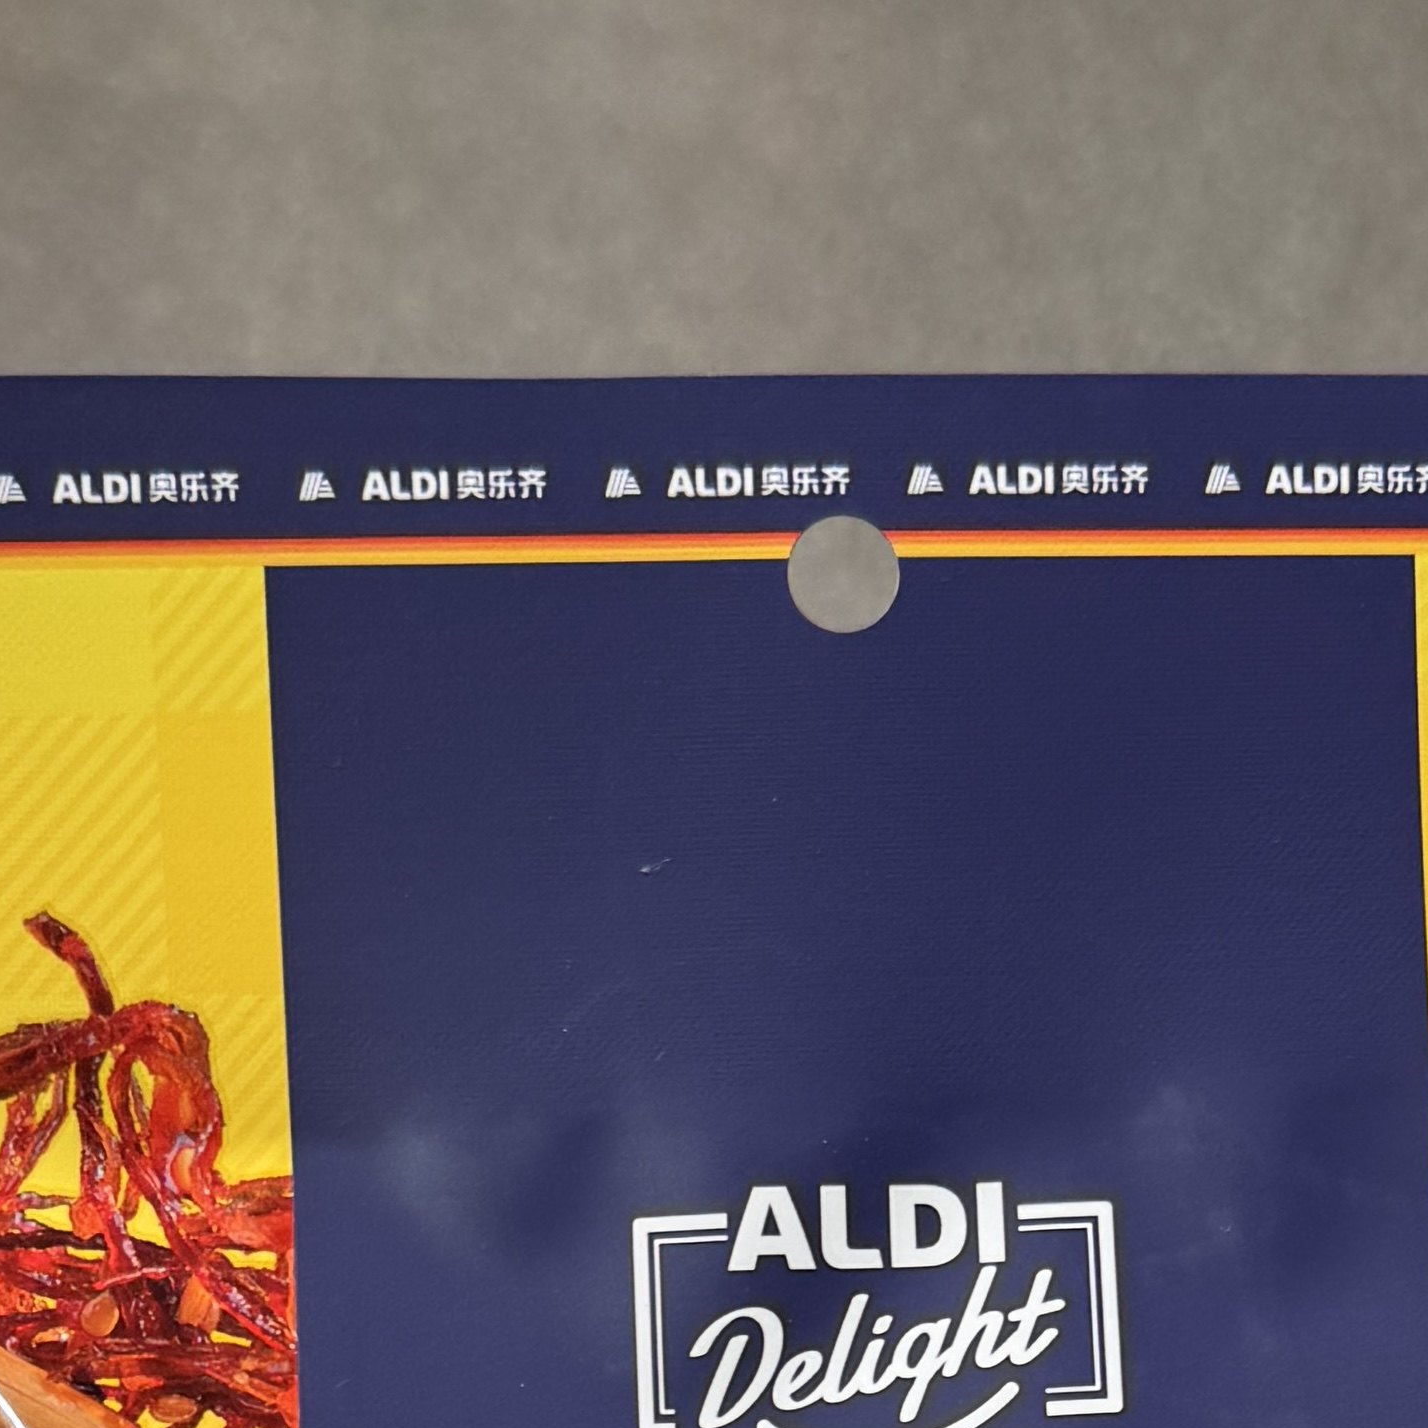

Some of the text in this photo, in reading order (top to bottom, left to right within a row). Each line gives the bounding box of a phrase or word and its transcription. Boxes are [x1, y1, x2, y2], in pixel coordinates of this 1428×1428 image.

[53, 471, 239, 504] ALDI 奥乐齐
[362, 468, 547, 501] ALDI 奥乐齐
[667, 465, 850, 498] ALDI 奥乐齐
[969, 464, 1149, 495] ALDI 奥乐齐
[1265, 464, 1350, 495] ALDI
[727, 1181, 1006, 1272] ALDI
[688, 1265, 1066, 1428] Delight
